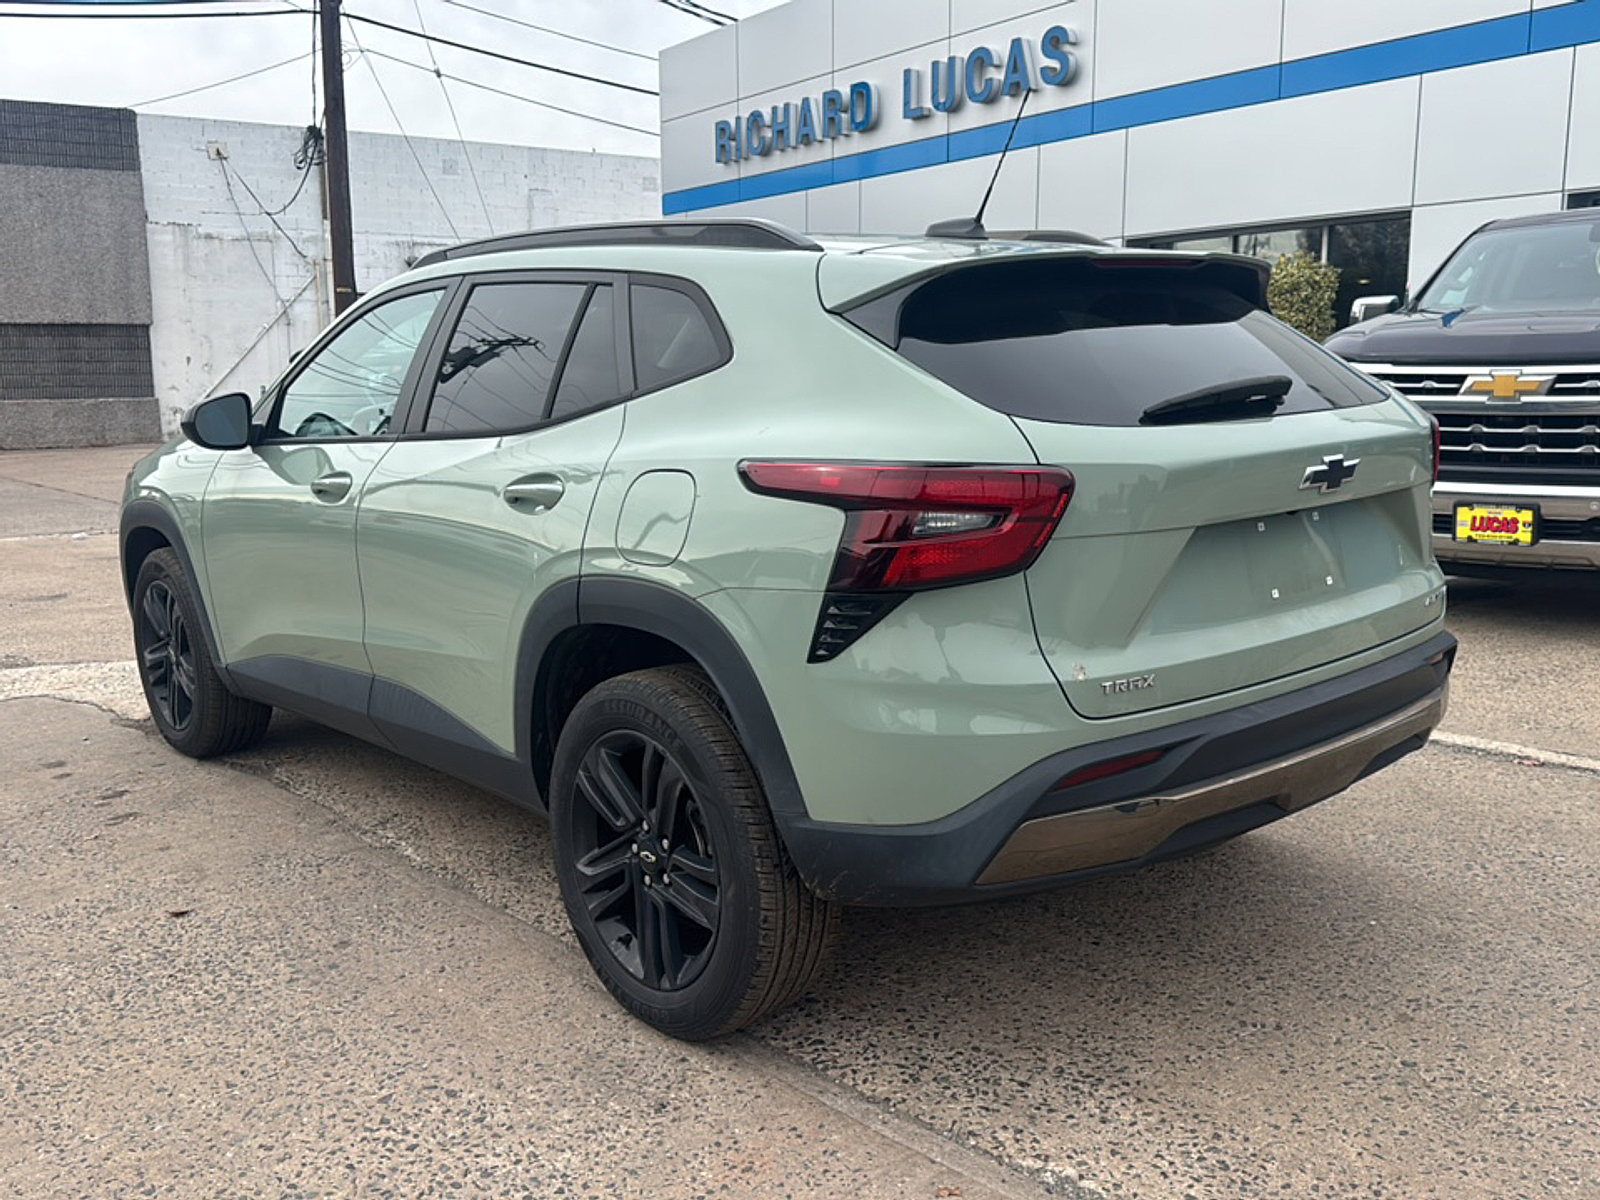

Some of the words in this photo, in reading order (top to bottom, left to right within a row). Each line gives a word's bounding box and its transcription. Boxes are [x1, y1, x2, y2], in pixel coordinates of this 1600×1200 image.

[715, 81, 877, 164] RICHARD
[903, 25, 1077, 119] LUCAS
[1470, 515, 1519, 534] LUCAS
[1101, 673, 1156, 694] TRAX
